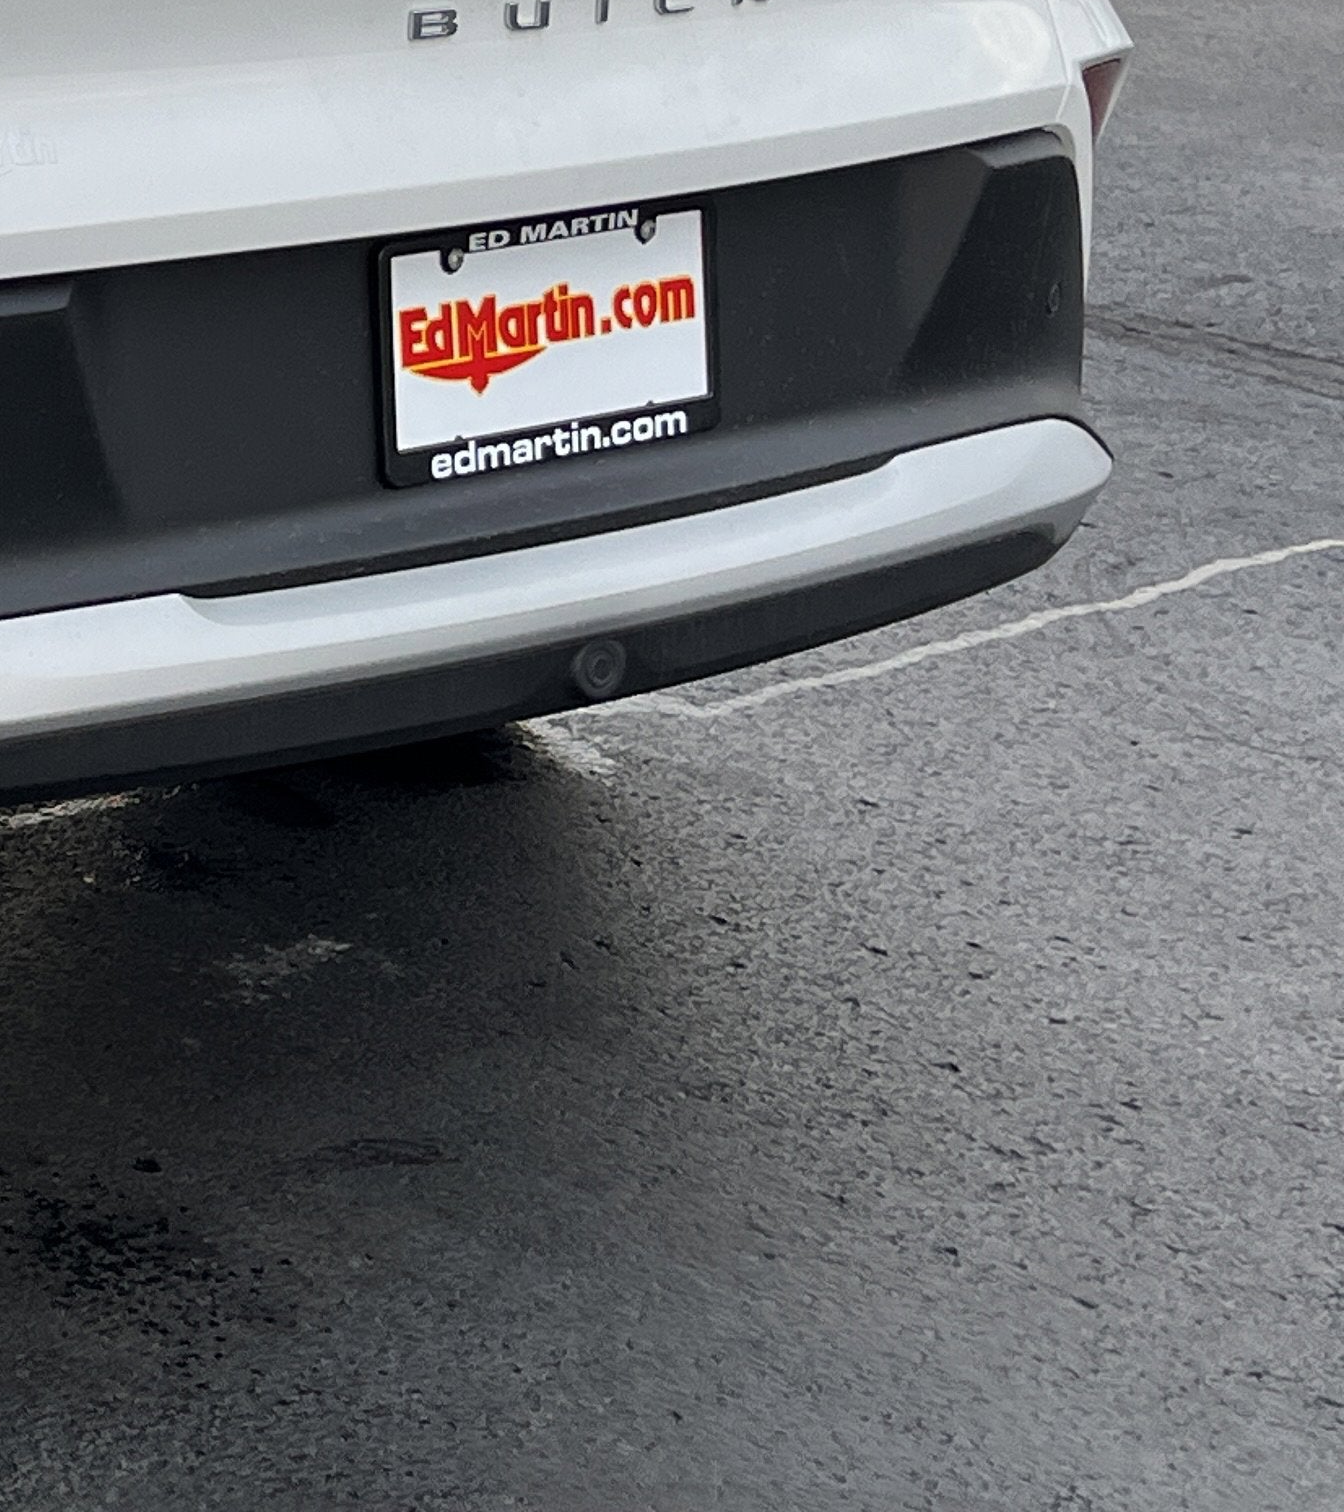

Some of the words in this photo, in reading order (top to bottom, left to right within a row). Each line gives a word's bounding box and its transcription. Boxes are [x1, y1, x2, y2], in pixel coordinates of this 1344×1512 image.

[467, 230, 511, 253] ED
[519, 208, 641, 245] MARTIN
[398, 274, 696, 370] EdMartin.com
[430, 409, 688, 480] edmartin.com
